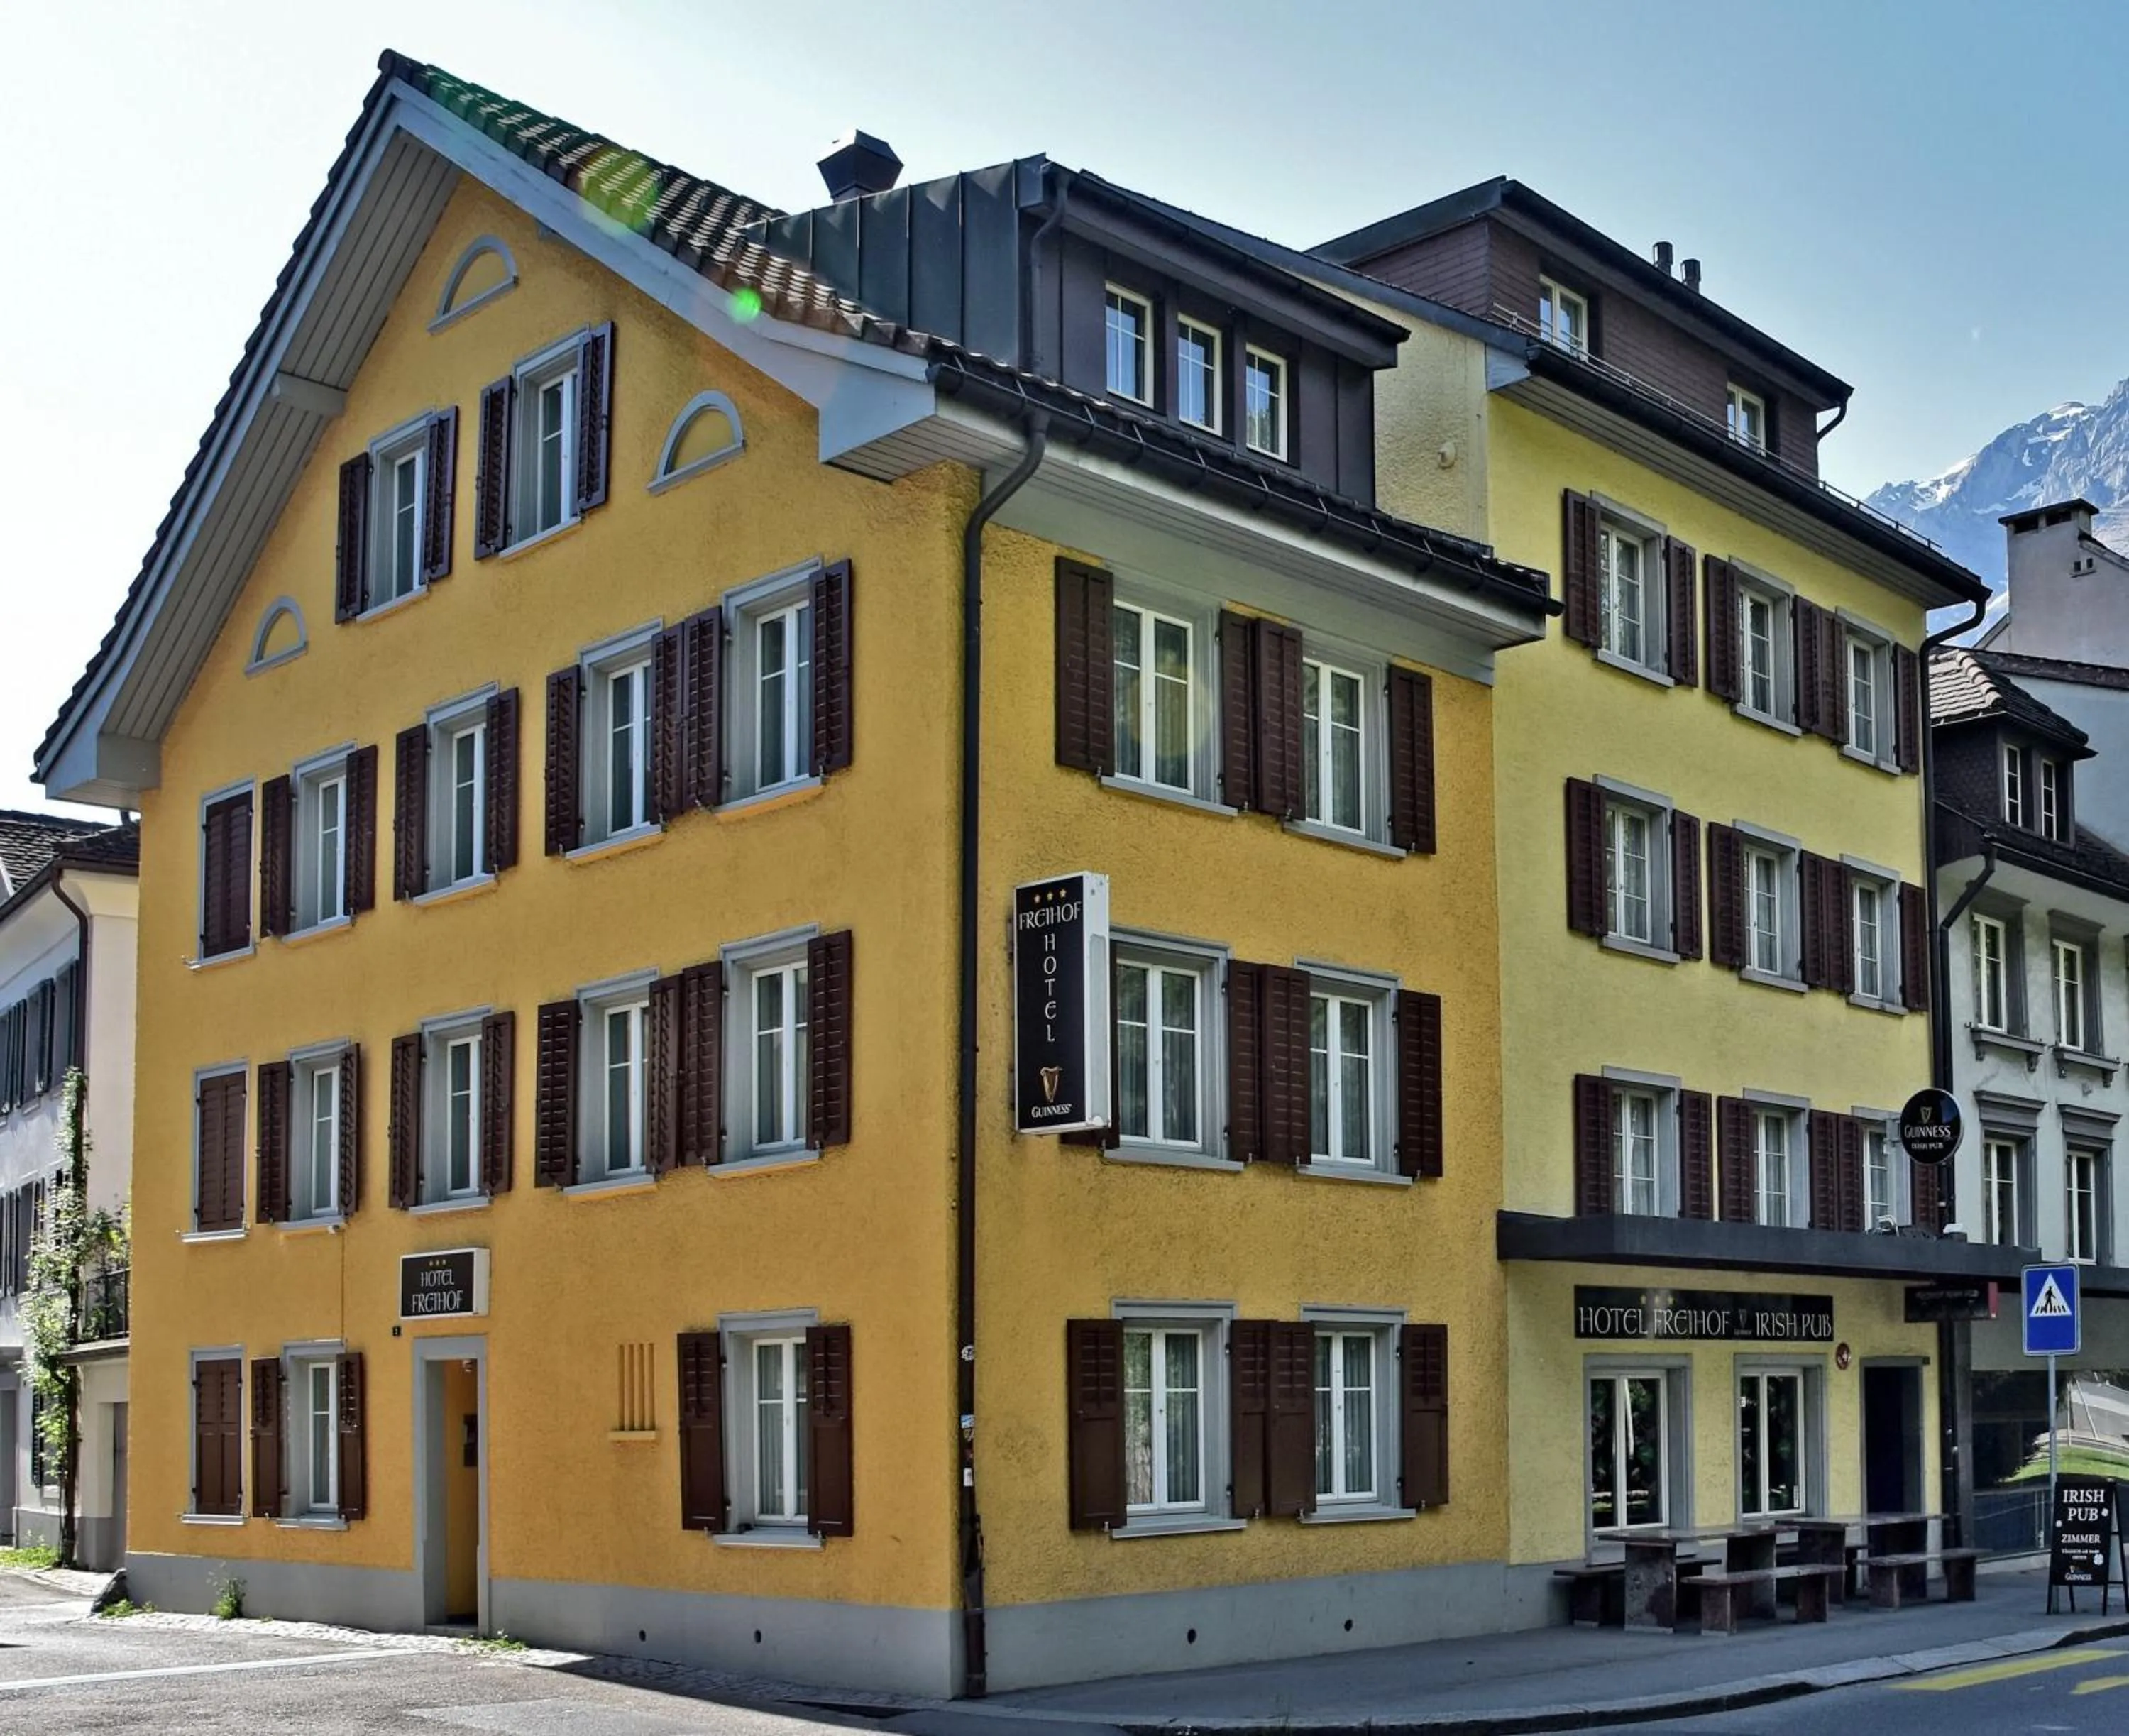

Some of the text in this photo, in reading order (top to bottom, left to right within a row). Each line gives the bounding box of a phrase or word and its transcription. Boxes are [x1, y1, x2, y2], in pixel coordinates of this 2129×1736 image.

[1018, 901, 1082, 931] FREIHOF
[1043, 933, 1057, 1043] HOTEL
[1031, 1103, 1072, 1119] GUINNESS
[1904, 1124, 1951, 1138] GUINNESS
[421, 1269, 455, 1287] HOTEL
[412, 1290, 463, 1313] FREIHOF
[1579, 1307, 1832, 1338] HOTEL FREIHOF IRISH PUB
[2062, 1489, 2105, 1503] IRISH
[2067, 1507, 2099, 1522] PUB
[2061, 1534, 2101, 1544] ZIMMER
